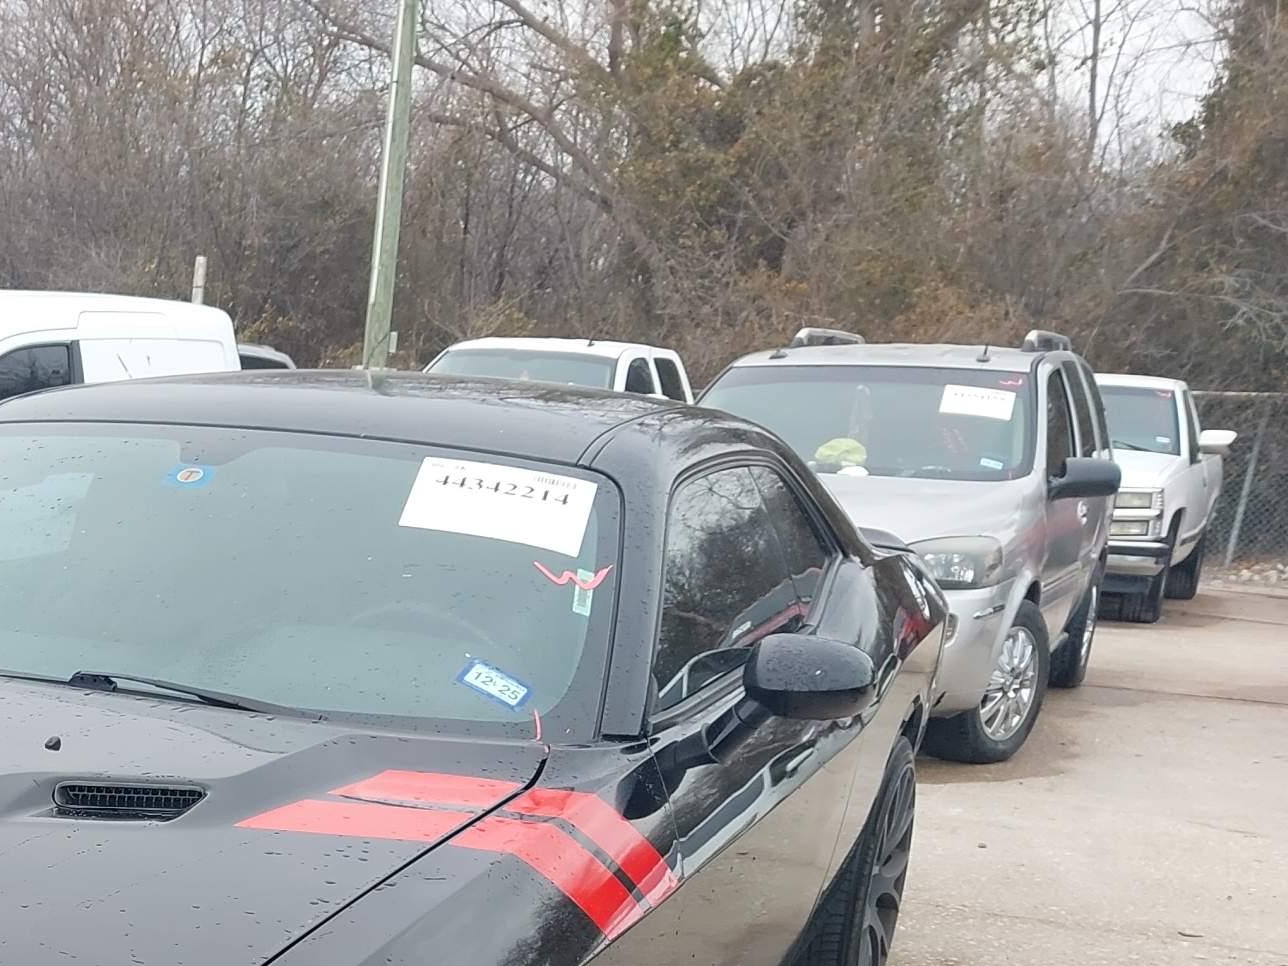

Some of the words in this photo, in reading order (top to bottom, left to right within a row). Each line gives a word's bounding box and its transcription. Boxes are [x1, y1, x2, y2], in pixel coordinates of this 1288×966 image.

[435, 474, 569, 505] 44342214
[474, 671, 493, 686] 12
[498, 684, 521, 701] 25
